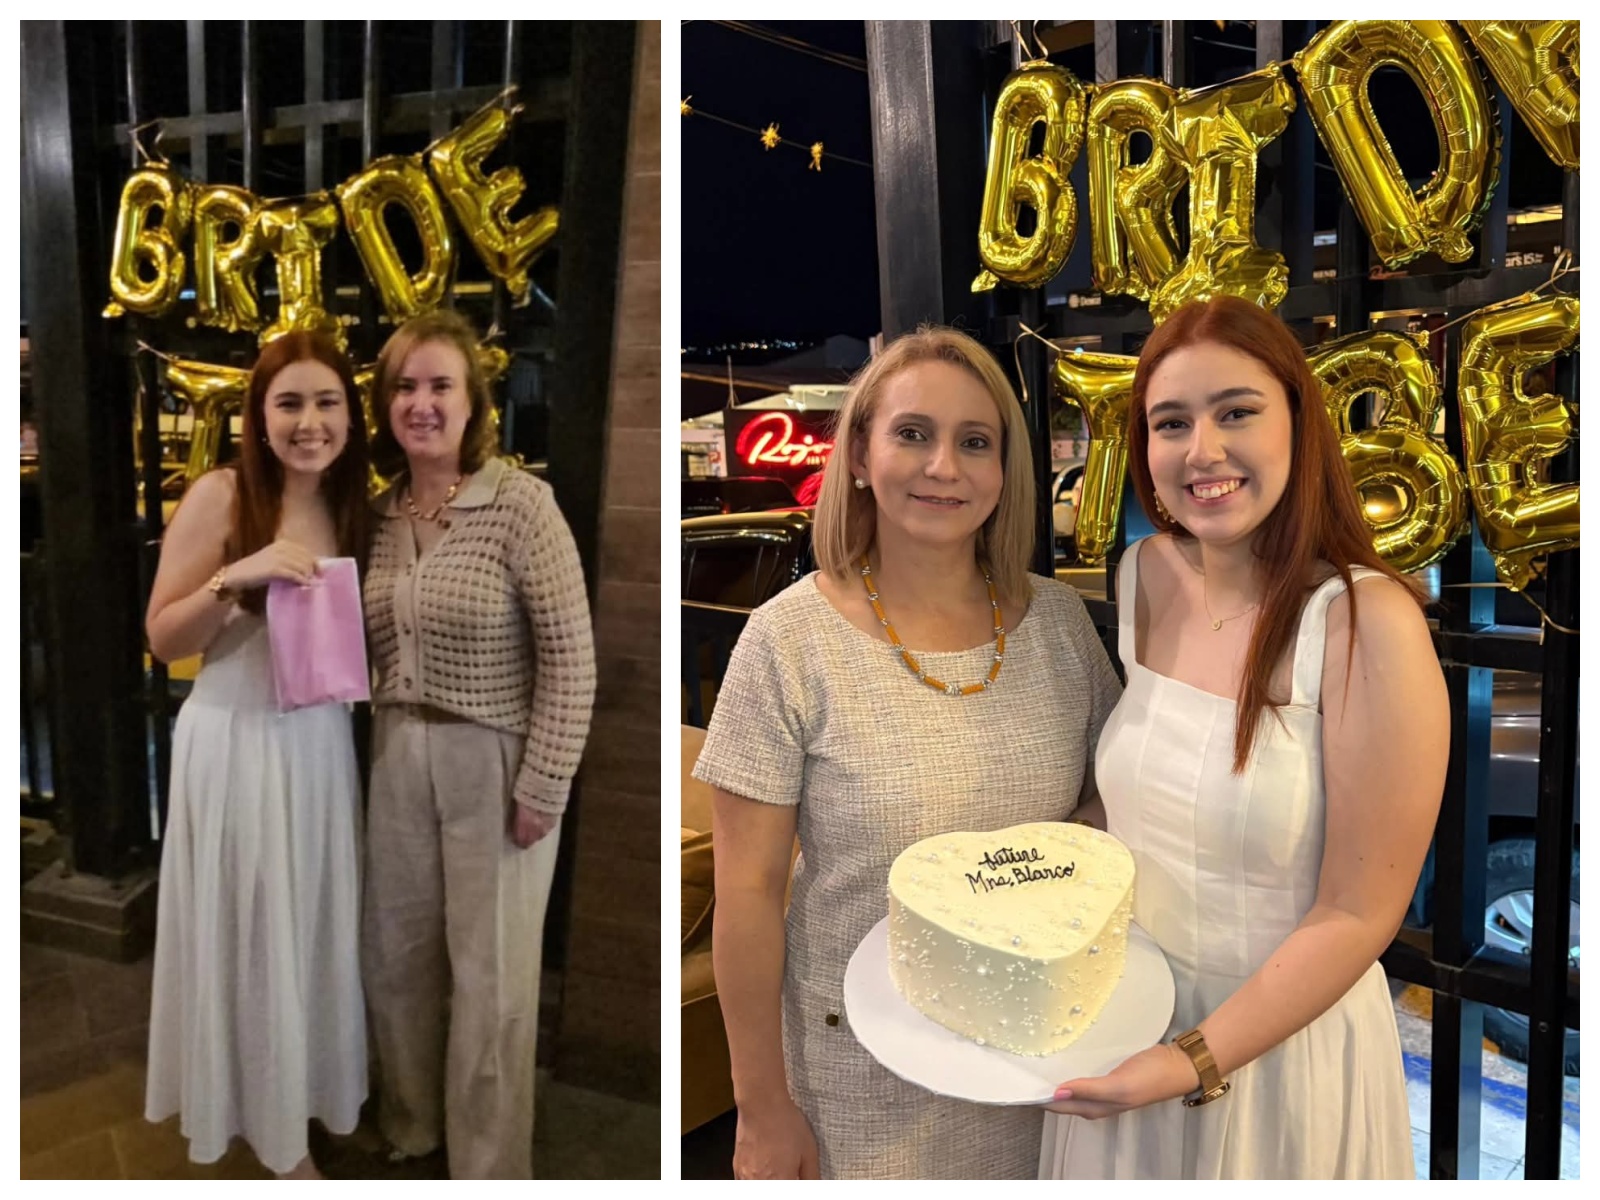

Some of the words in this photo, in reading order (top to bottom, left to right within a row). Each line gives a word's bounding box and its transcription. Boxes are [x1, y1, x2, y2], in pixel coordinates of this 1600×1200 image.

[103, 104, 561, 352] BRIDE
[978, 847, 1045, 871] future
[965, 870, 1014, 894] Mrs.
